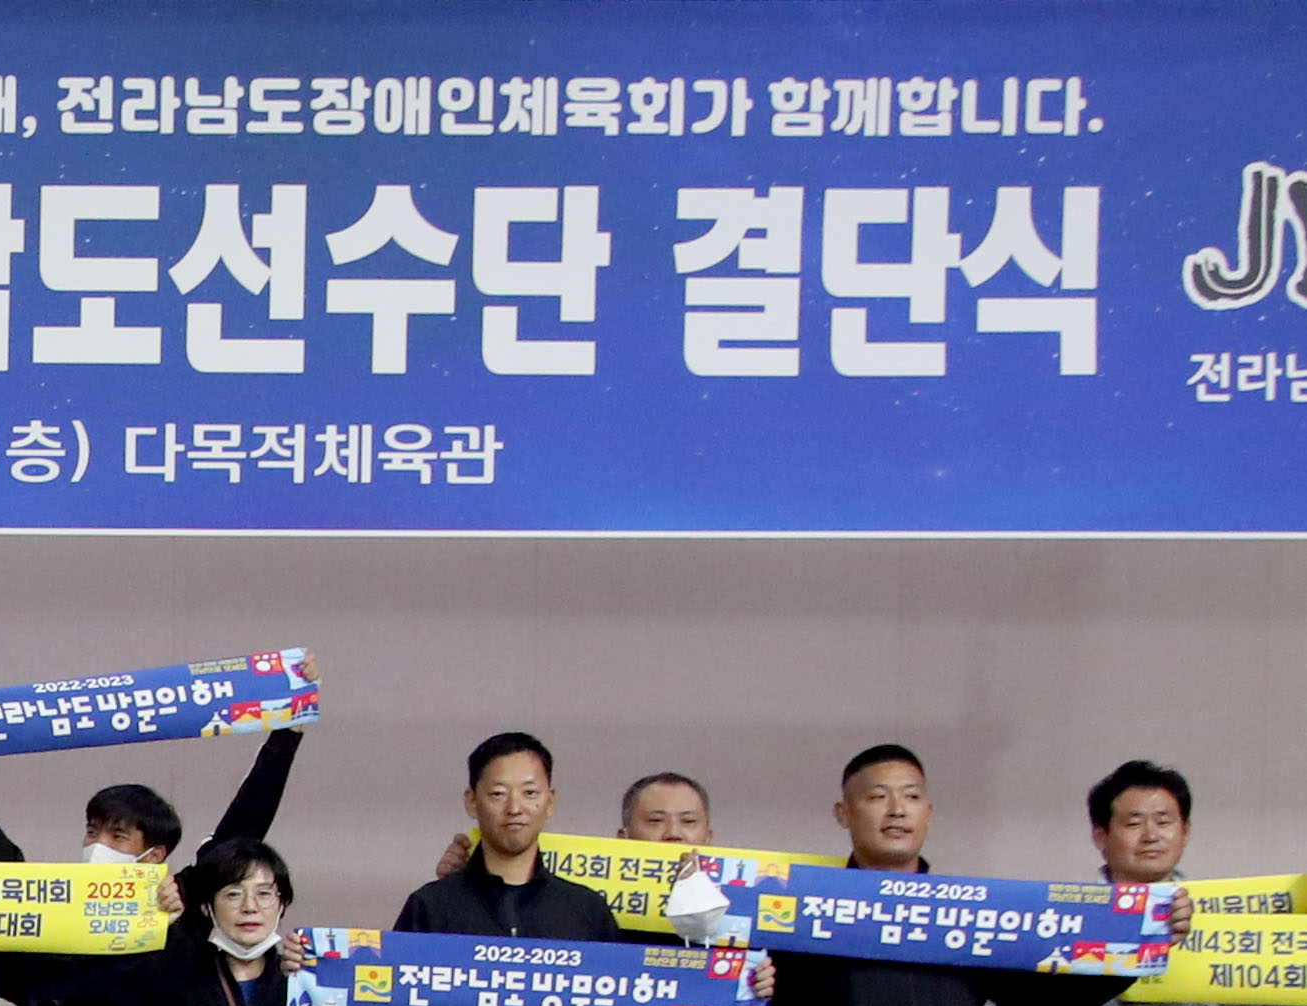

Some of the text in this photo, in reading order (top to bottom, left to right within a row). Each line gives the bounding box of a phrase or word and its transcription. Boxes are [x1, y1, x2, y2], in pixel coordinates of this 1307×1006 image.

[57, 76, 753, 136] 전라남도장애인체육회가
[768, 76, 1103, 136] 함께합니다.
[673, 186, 1100, 376] 결단식
[125, 423, 504, 484] 다목적체육관
[33, 675, 134, 692] 2022-2023
[96, 686, 187, 732] 방문의
[191, 680, 233, 705] 해
[88, 882, 135, 899] 2023
[880, 880, 987, 901] 2022-2023
[84, 902, 138, 916] 전남으로
[89, 920, 129, 934] 오세요
[803, 896, 1083, 955] 전라남도 방문의 해
[474, 945, 581, 966] 2022-2023
[633, 971, 678, 1002] 해
[1209, 964, 1306, 988] 제104회
